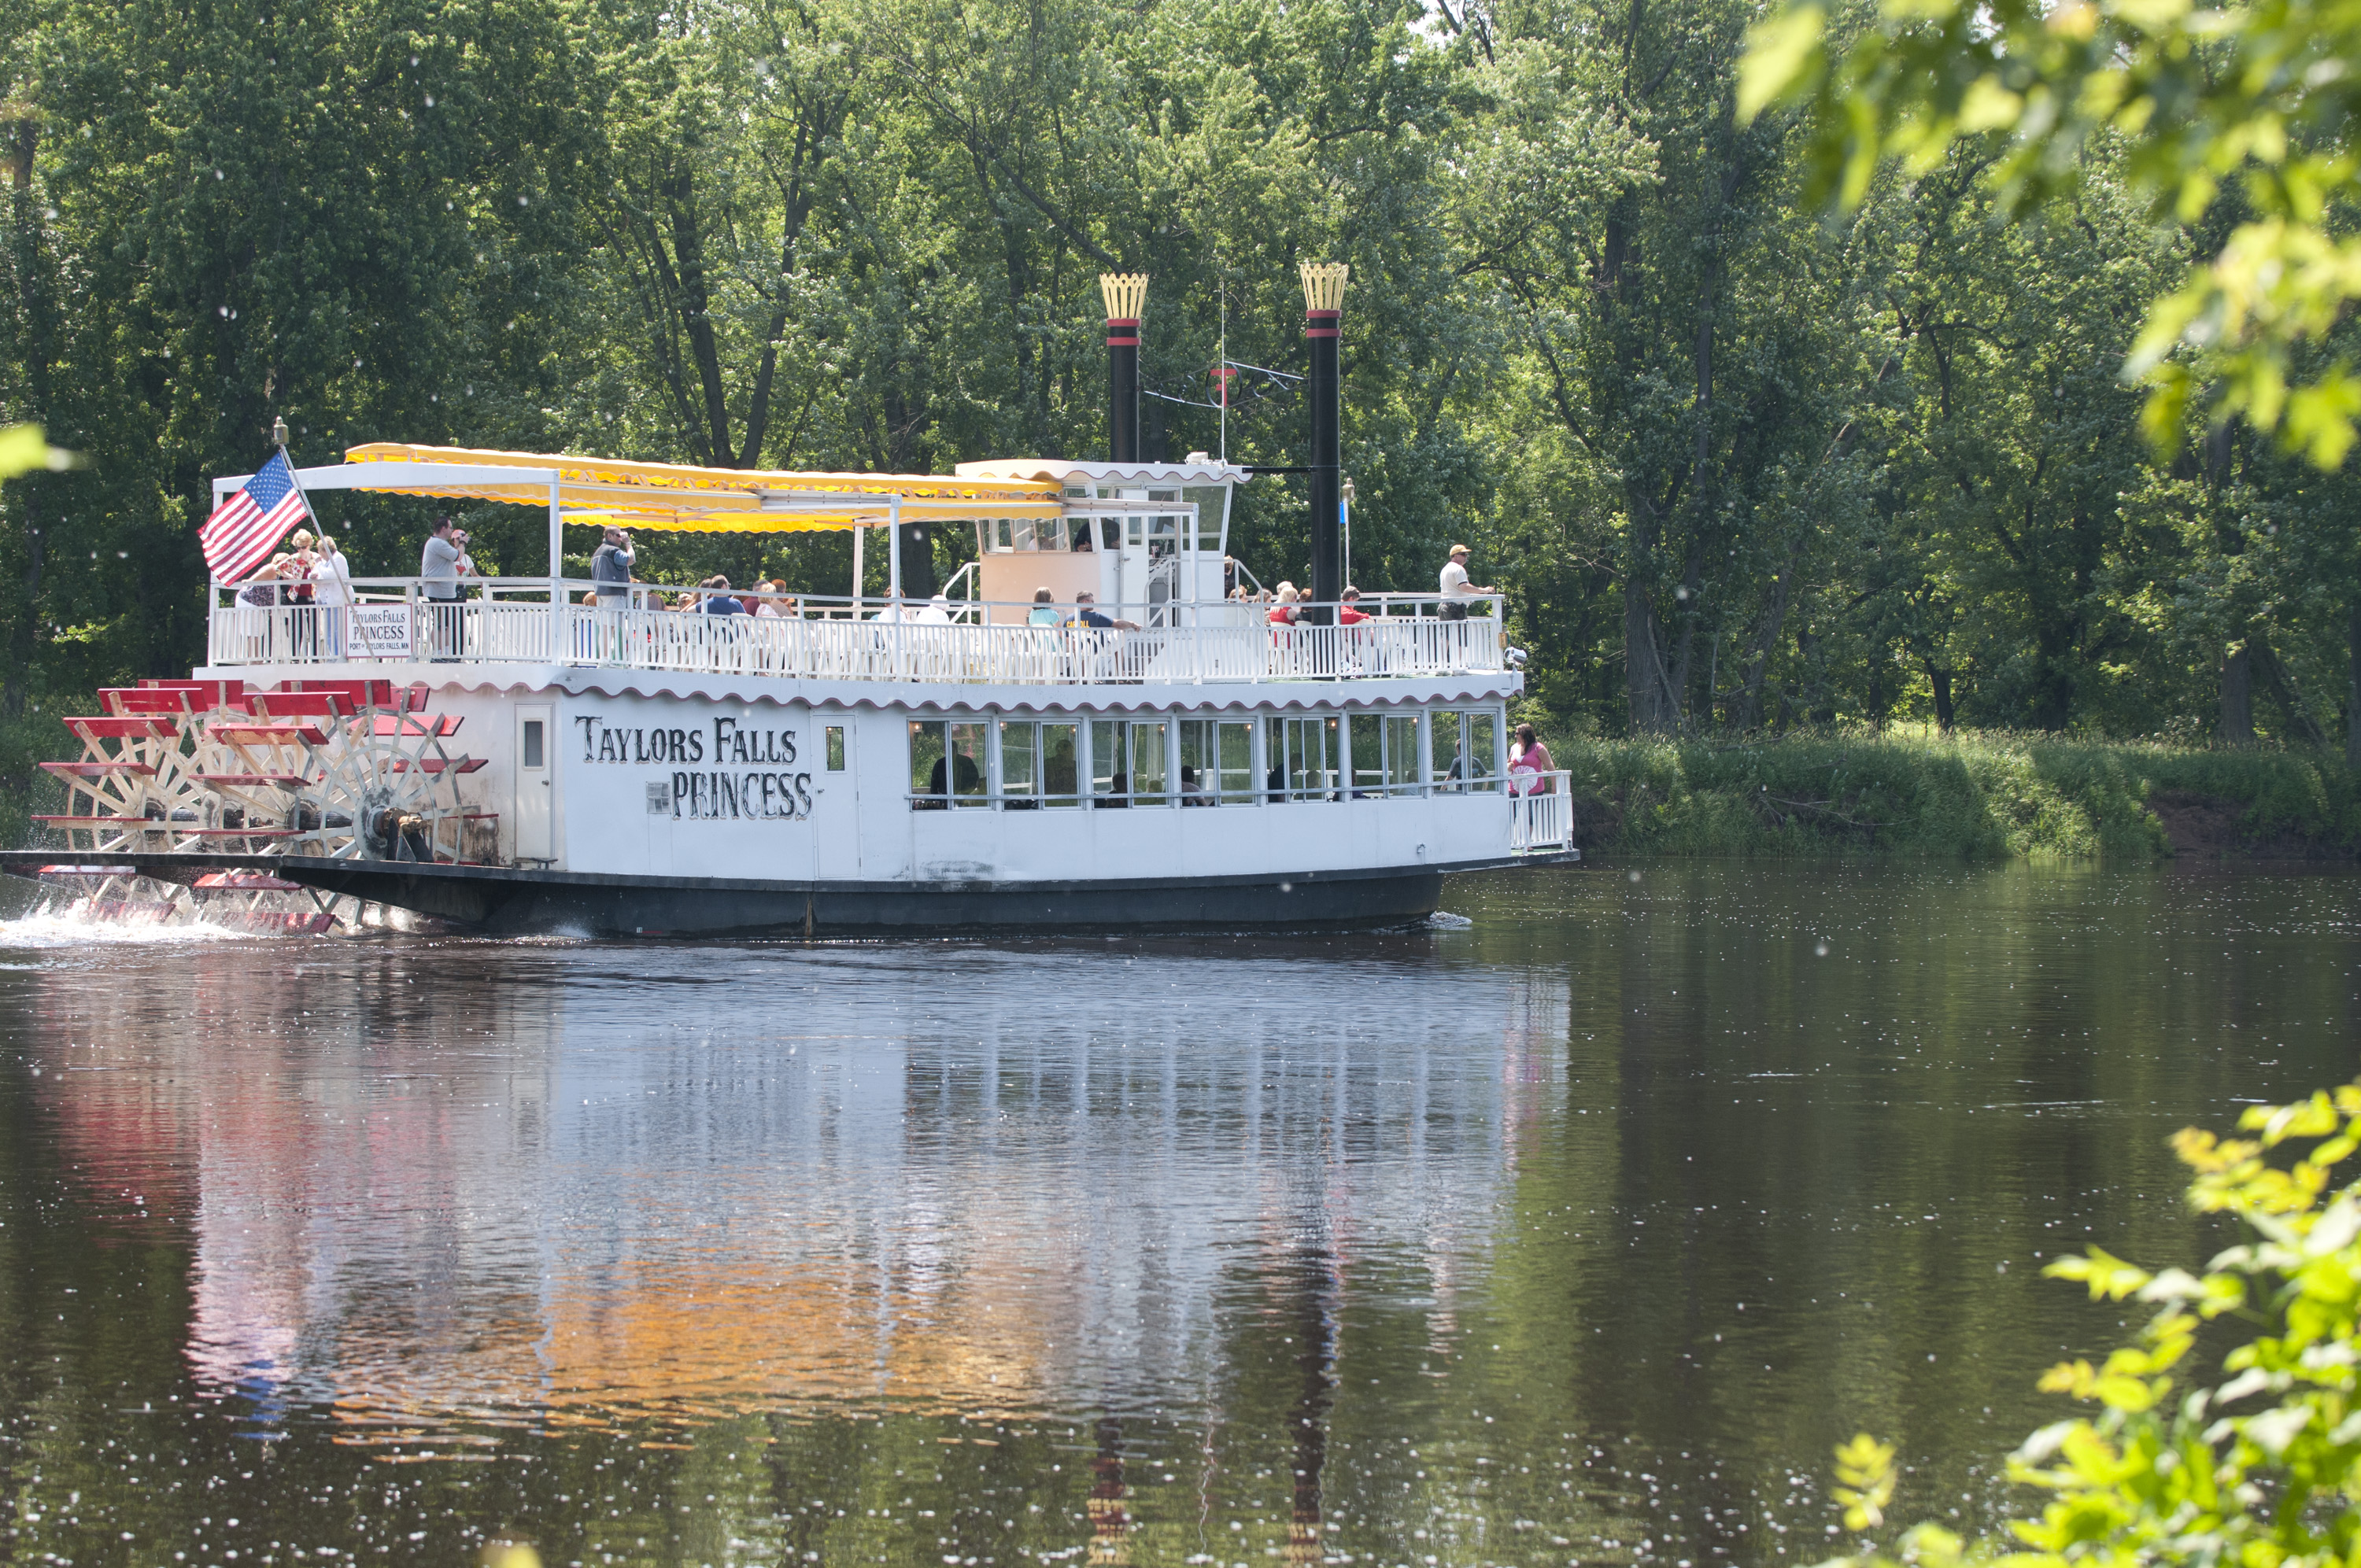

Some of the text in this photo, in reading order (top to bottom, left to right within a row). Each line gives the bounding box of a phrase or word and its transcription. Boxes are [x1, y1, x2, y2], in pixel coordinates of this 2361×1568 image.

[382, 610, 405, 623] FALLS
[574, 715, 797, 765] TAYLORS FALLS
[671, 771, 813, 821] PRINCESS
